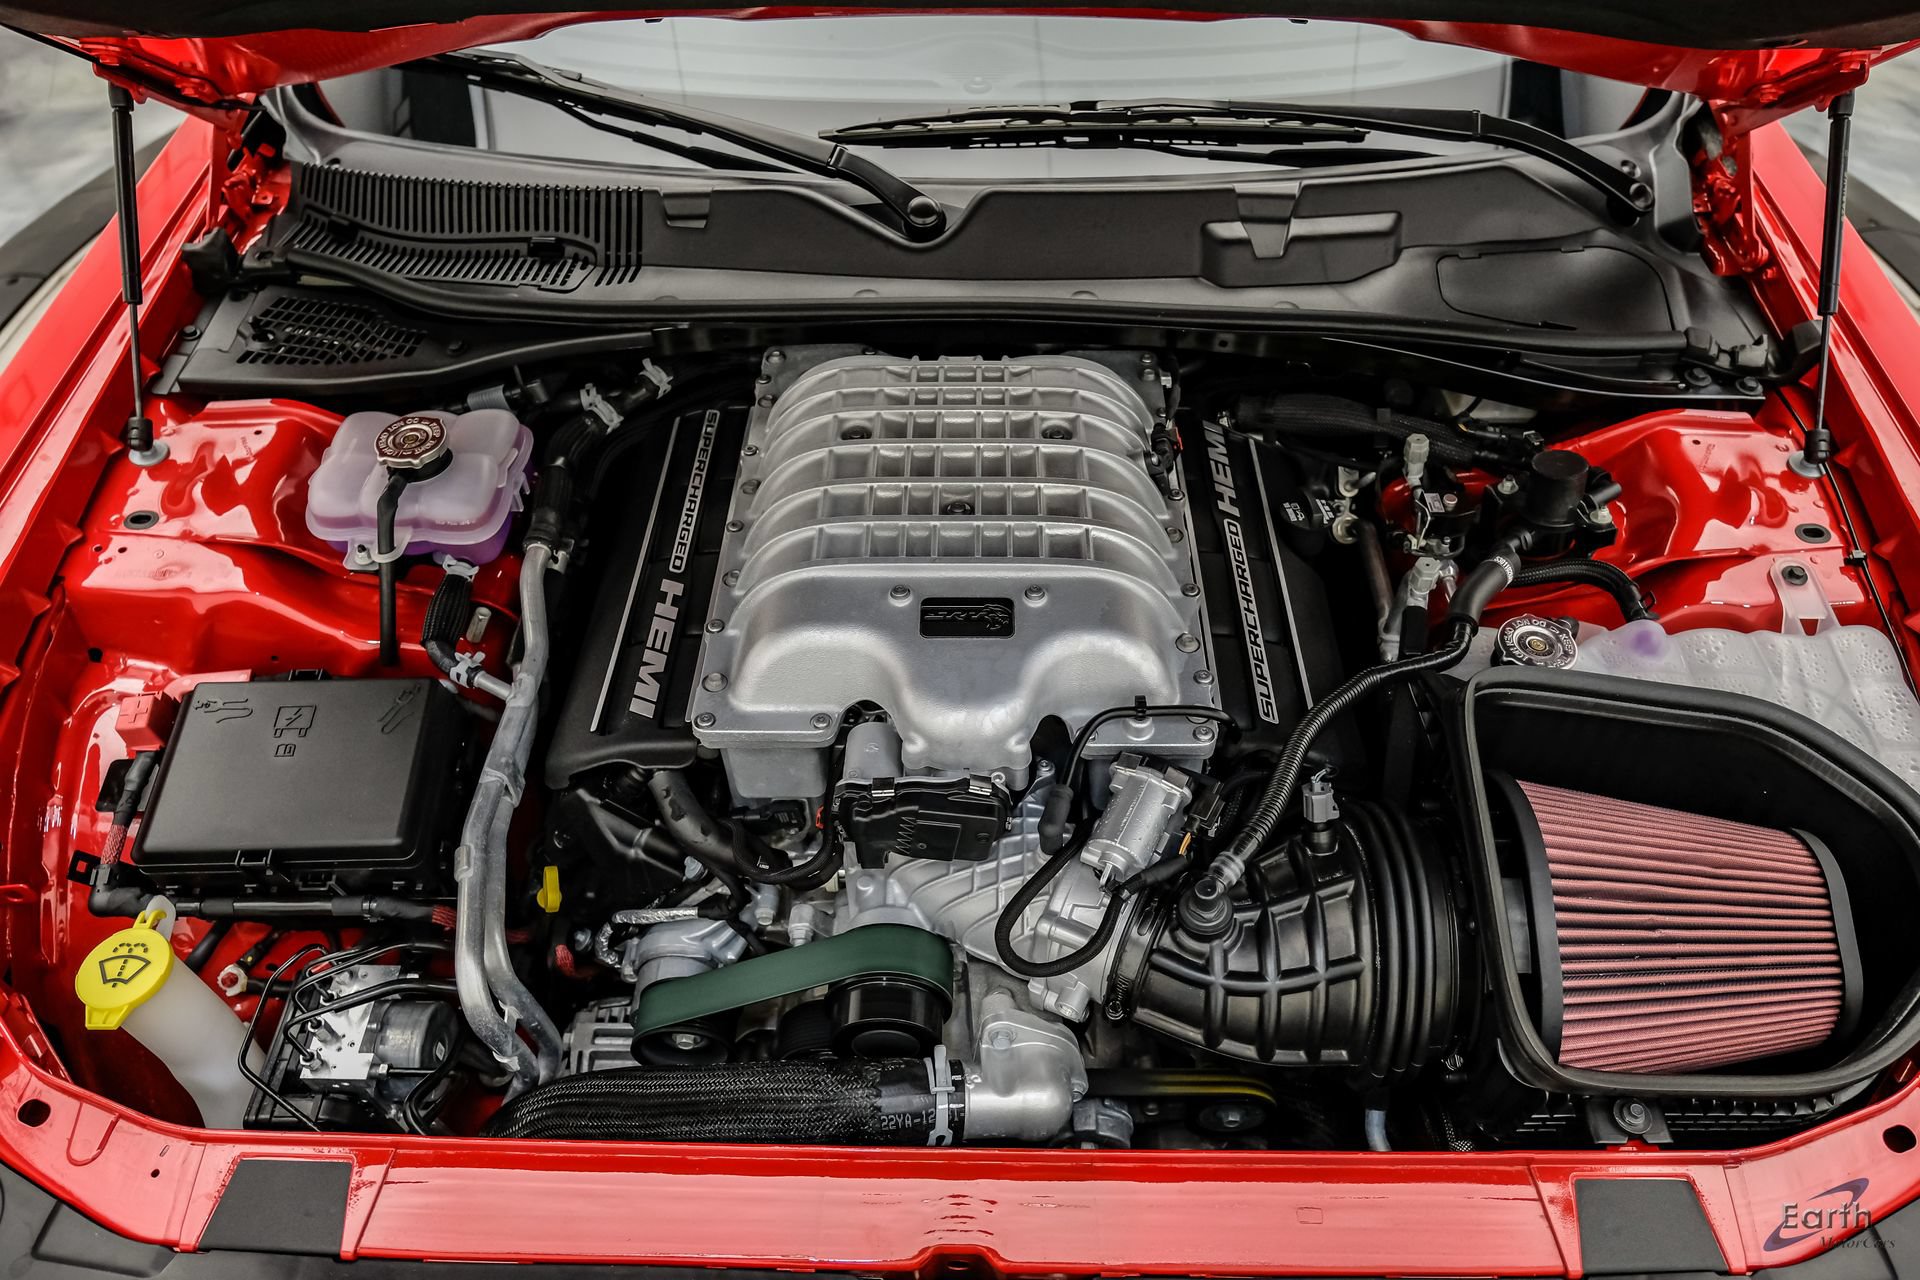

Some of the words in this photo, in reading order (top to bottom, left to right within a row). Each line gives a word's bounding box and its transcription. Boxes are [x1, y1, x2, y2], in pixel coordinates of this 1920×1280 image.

[669, 409, 720, 574] SUPERCHARGED
[1202, 420, 1240, 517] HEMI
[629, 579, 684, 718] HEMI
[1214, 519, 1279, 724] SUPERCHARGED
[1512, 618, 1530, 628] NOT
[1532, 619, 1546, 627] DO
[1560, 633, 1573, 654] KEEP
[1510, 647, 1528, 661] HOT
